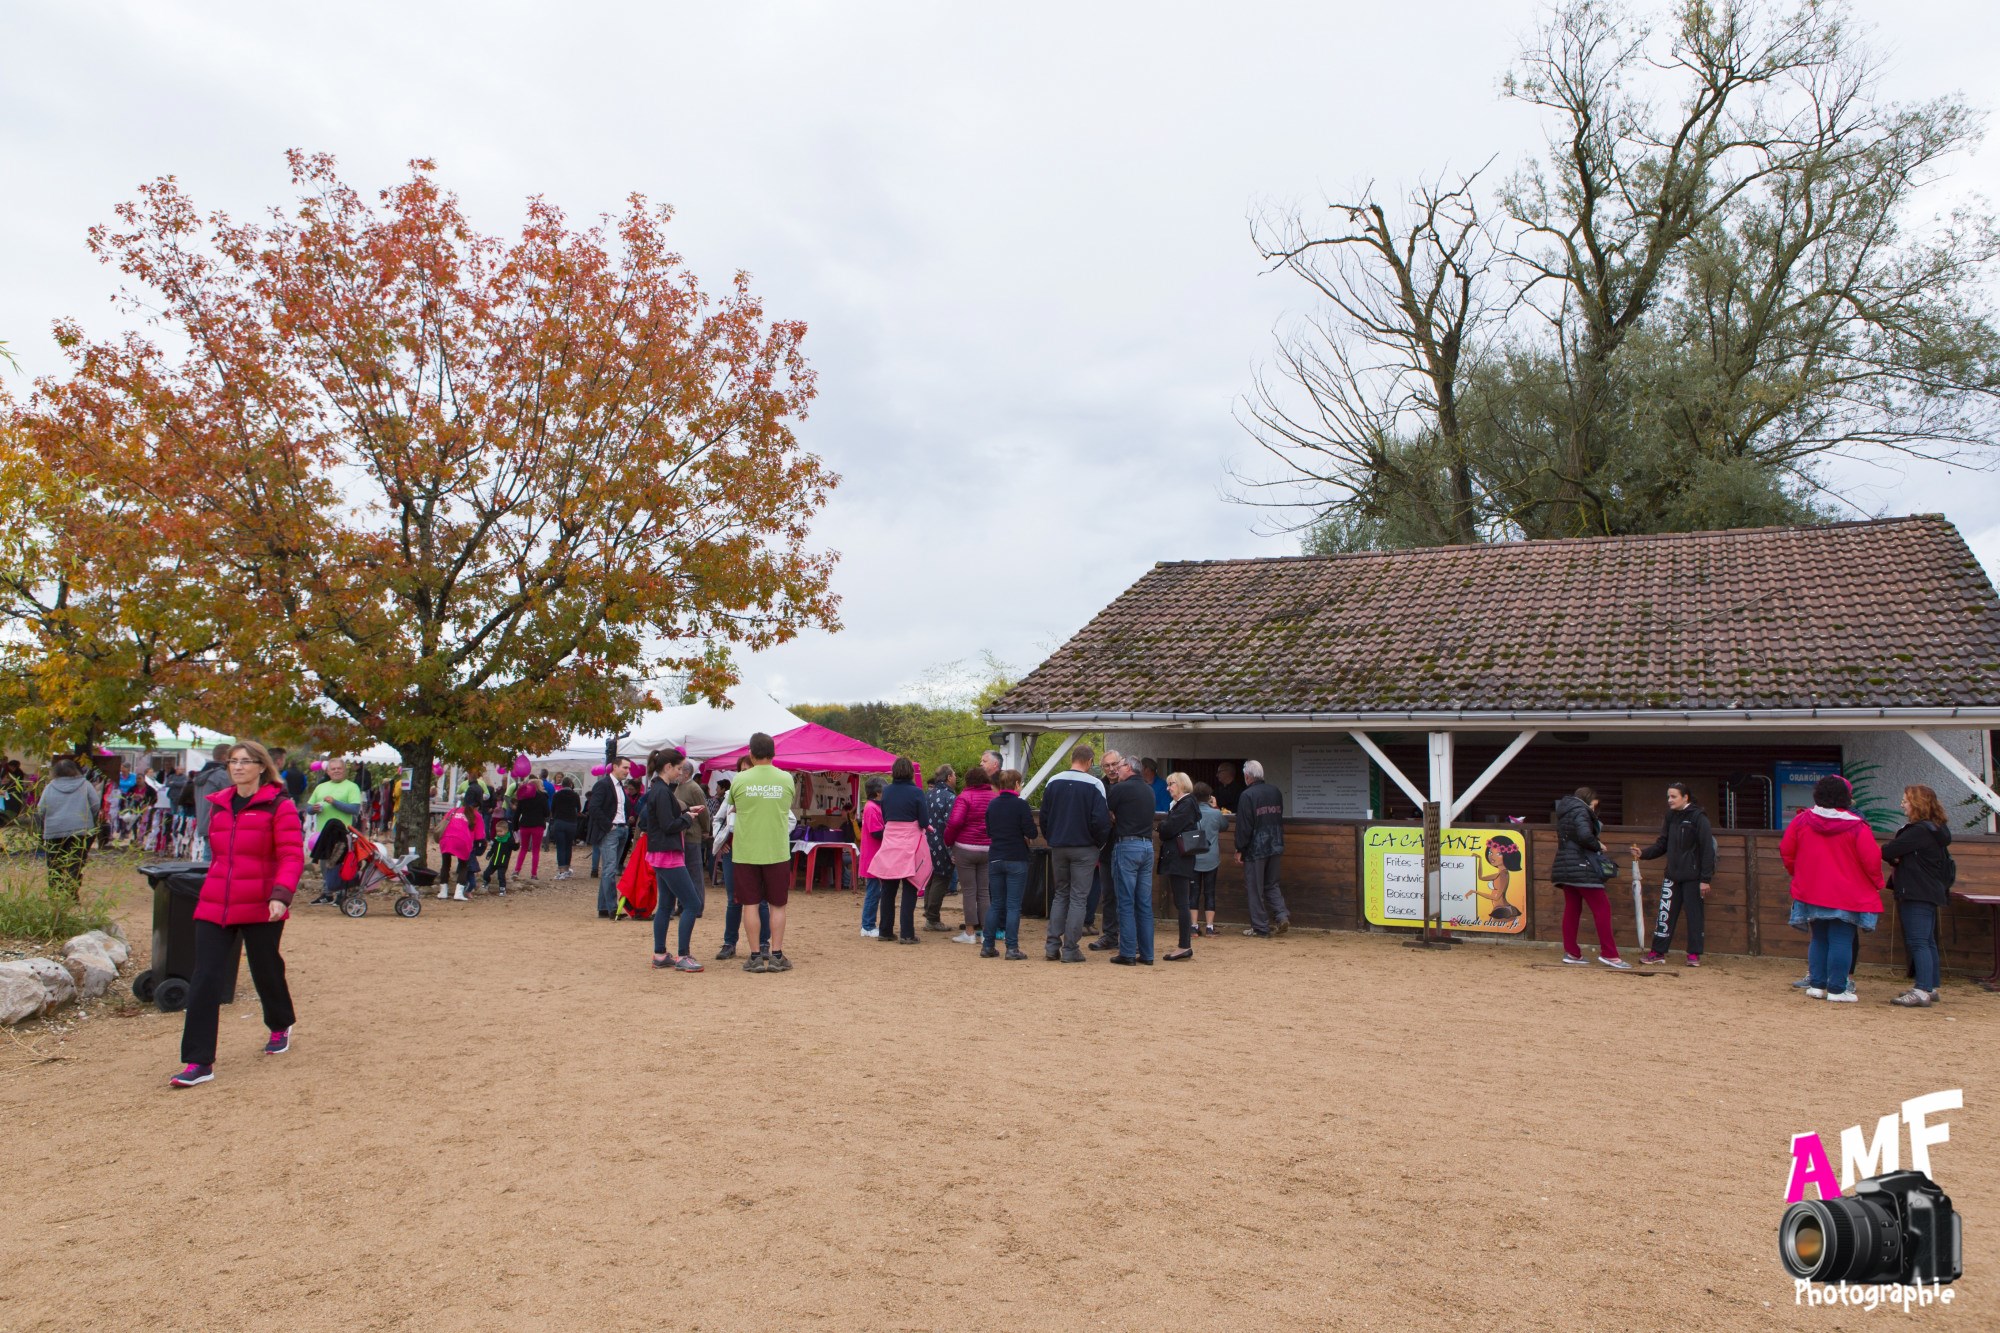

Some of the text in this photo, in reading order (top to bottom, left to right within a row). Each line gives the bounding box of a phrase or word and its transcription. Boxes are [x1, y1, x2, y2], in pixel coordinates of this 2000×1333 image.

[1369, 833, 1482, 851] LA CAANE
[1386, 855, 1411, 867] Frites
[1370, 852, 1378, 891] SNACK
[1386, 872, 1425, 884] Sandwic
[1386, 905, 1417, 916] Glaces
